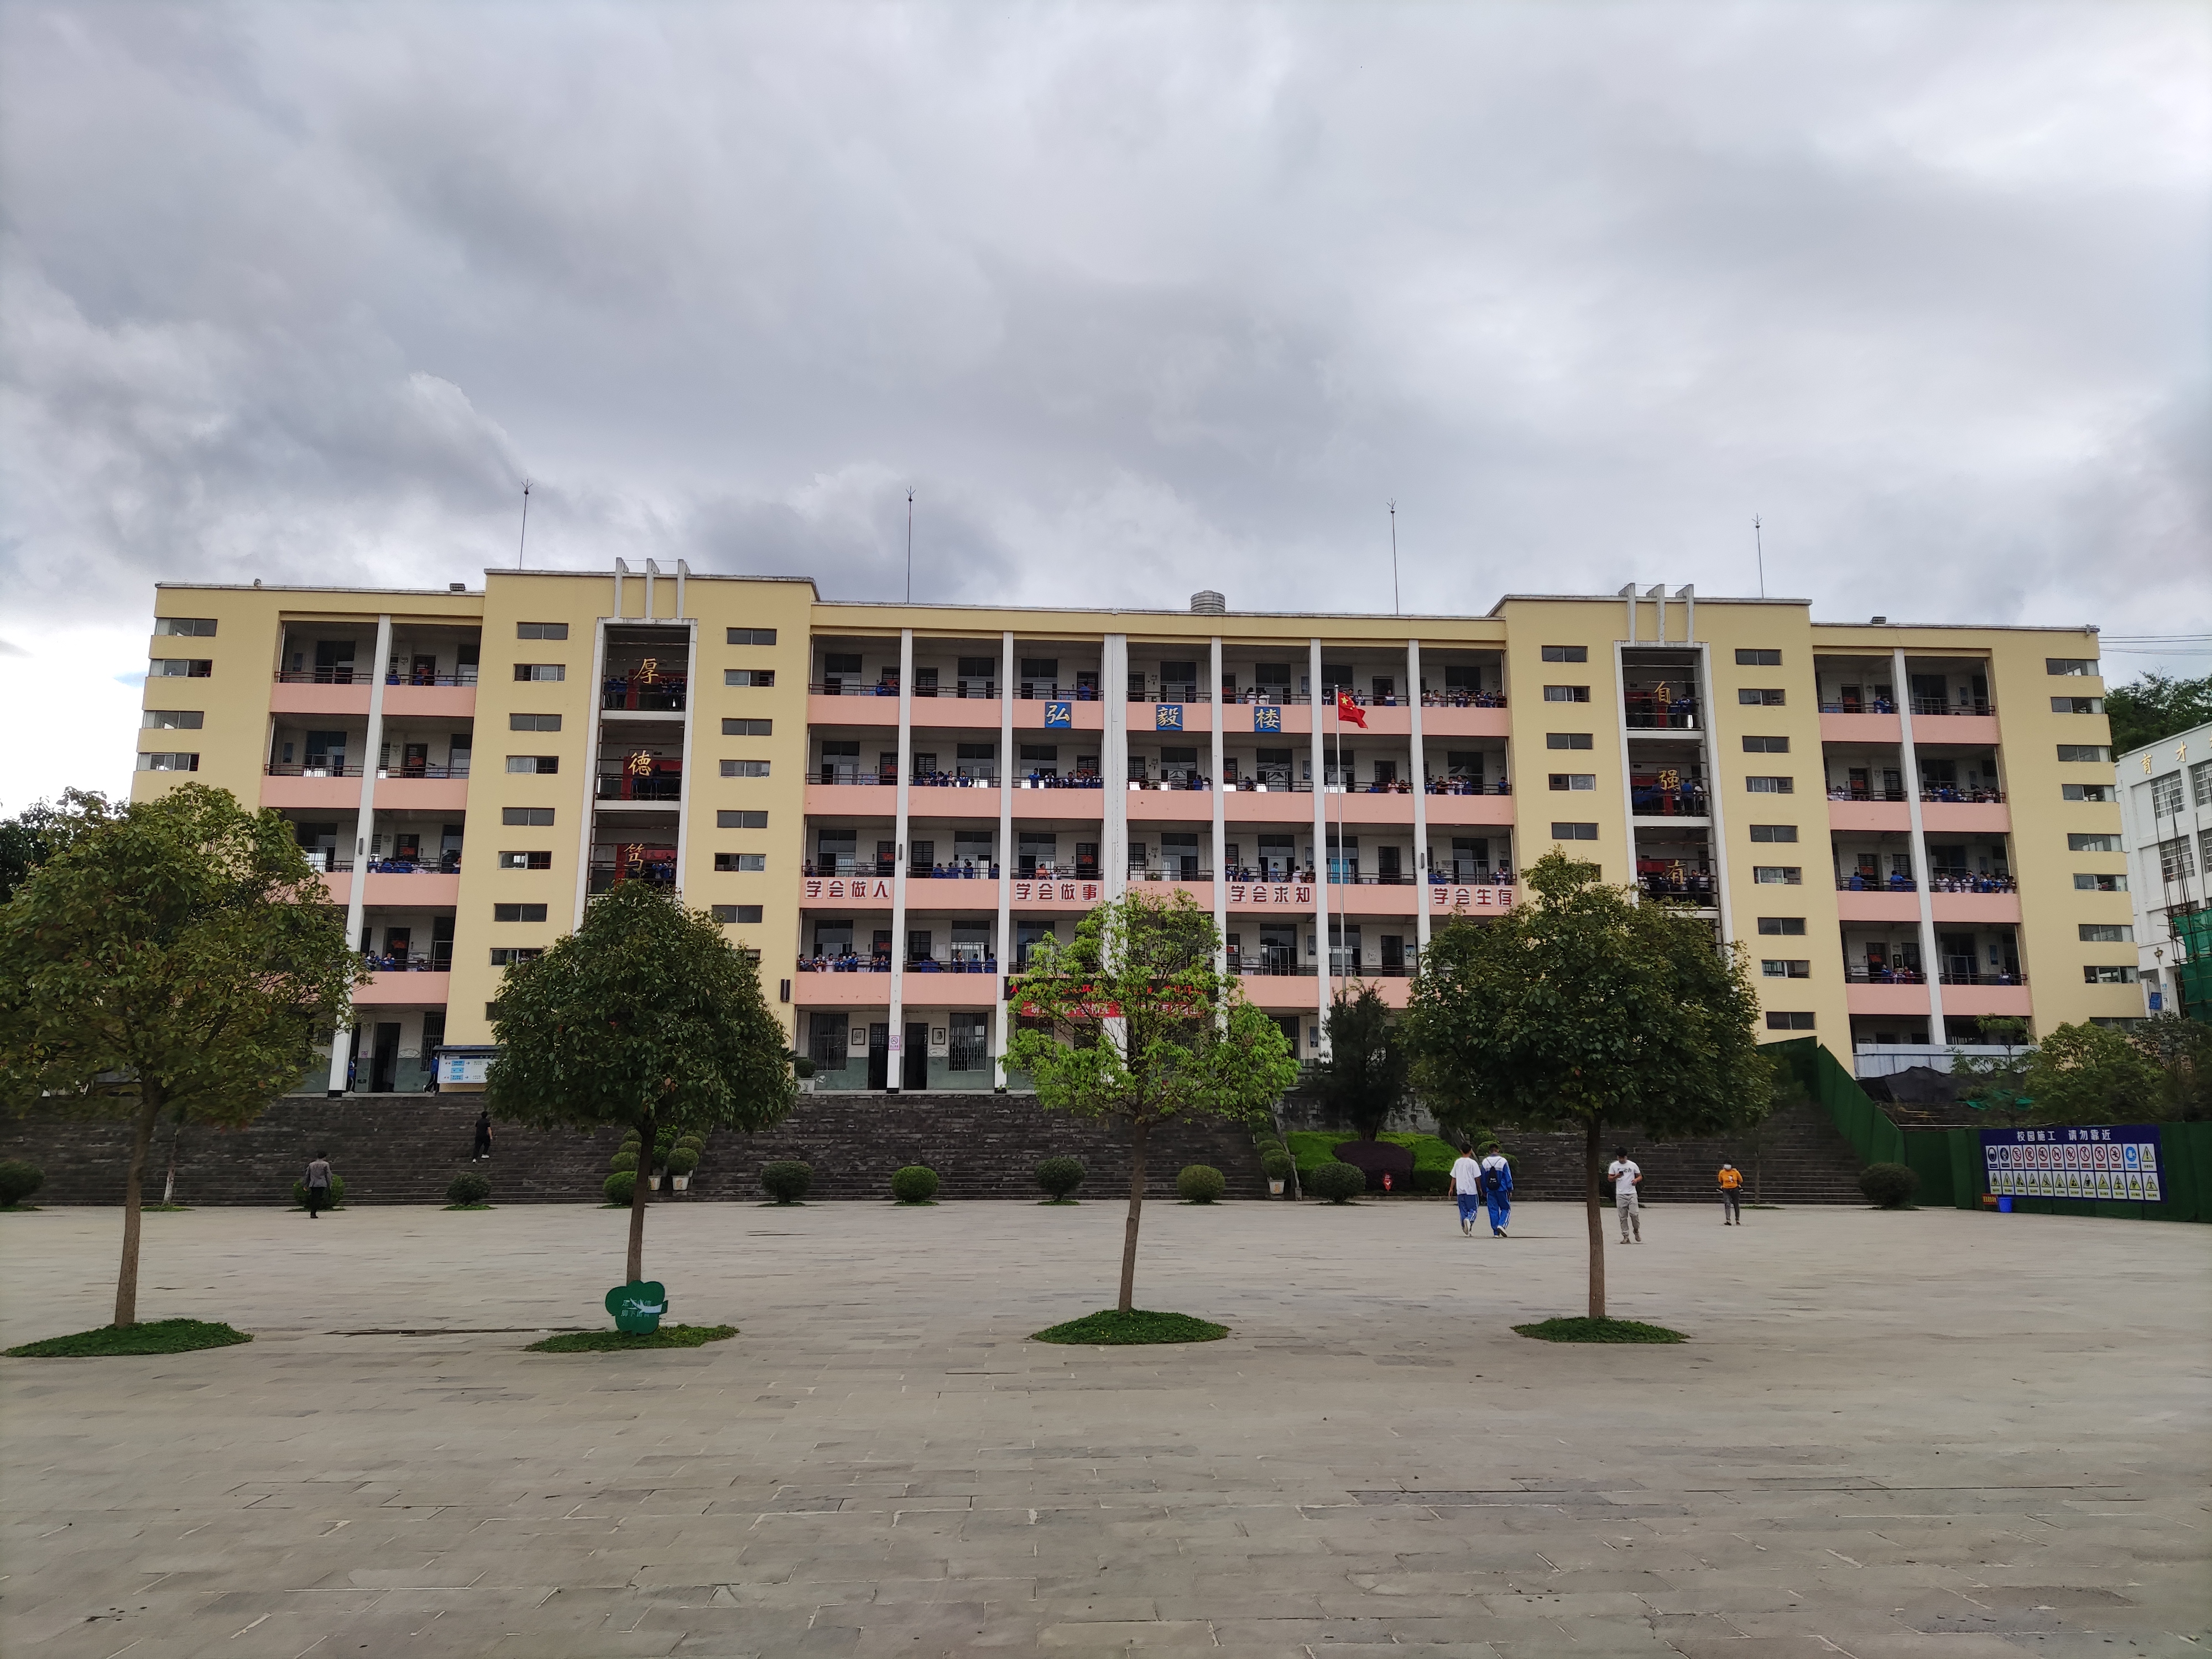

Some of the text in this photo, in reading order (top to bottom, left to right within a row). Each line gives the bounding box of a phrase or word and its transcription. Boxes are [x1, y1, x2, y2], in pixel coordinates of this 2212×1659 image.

[1046, 705, 1279, 730] 弘毅楼
[806, 880, 889, 898] 学会做人
[1016, 882, 1098, 901] 学会做事
[1231, 885, 1311, 902] 学会求知
[1434, 888, 1512, 905] 学会生存
[2017, 1129, 2111, 1142] 校园施工 请勿靠近
